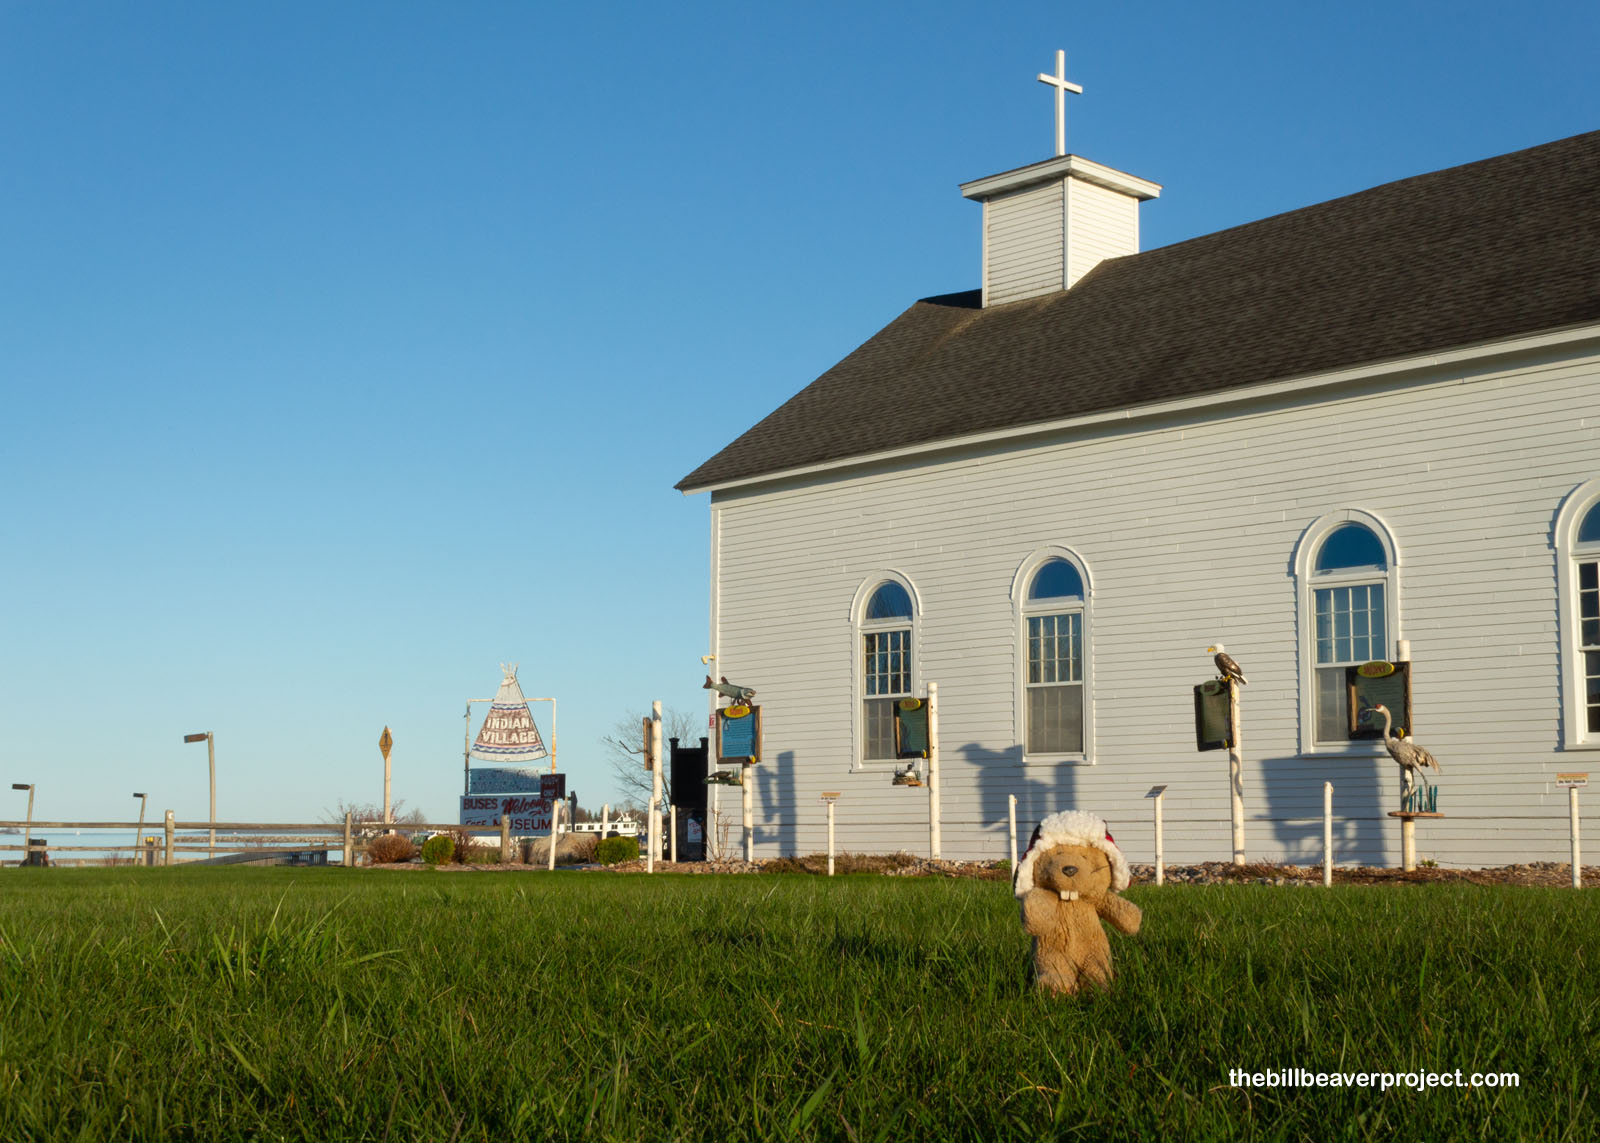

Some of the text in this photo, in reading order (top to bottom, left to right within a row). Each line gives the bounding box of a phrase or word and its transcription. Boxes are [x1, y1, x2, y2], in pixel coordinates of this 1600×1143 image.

[487, 717, 530, 729] INDIAN
[481, 731, 536, 744] VILLAGE
[463, 796, 551, 815] BUSES Welcome
